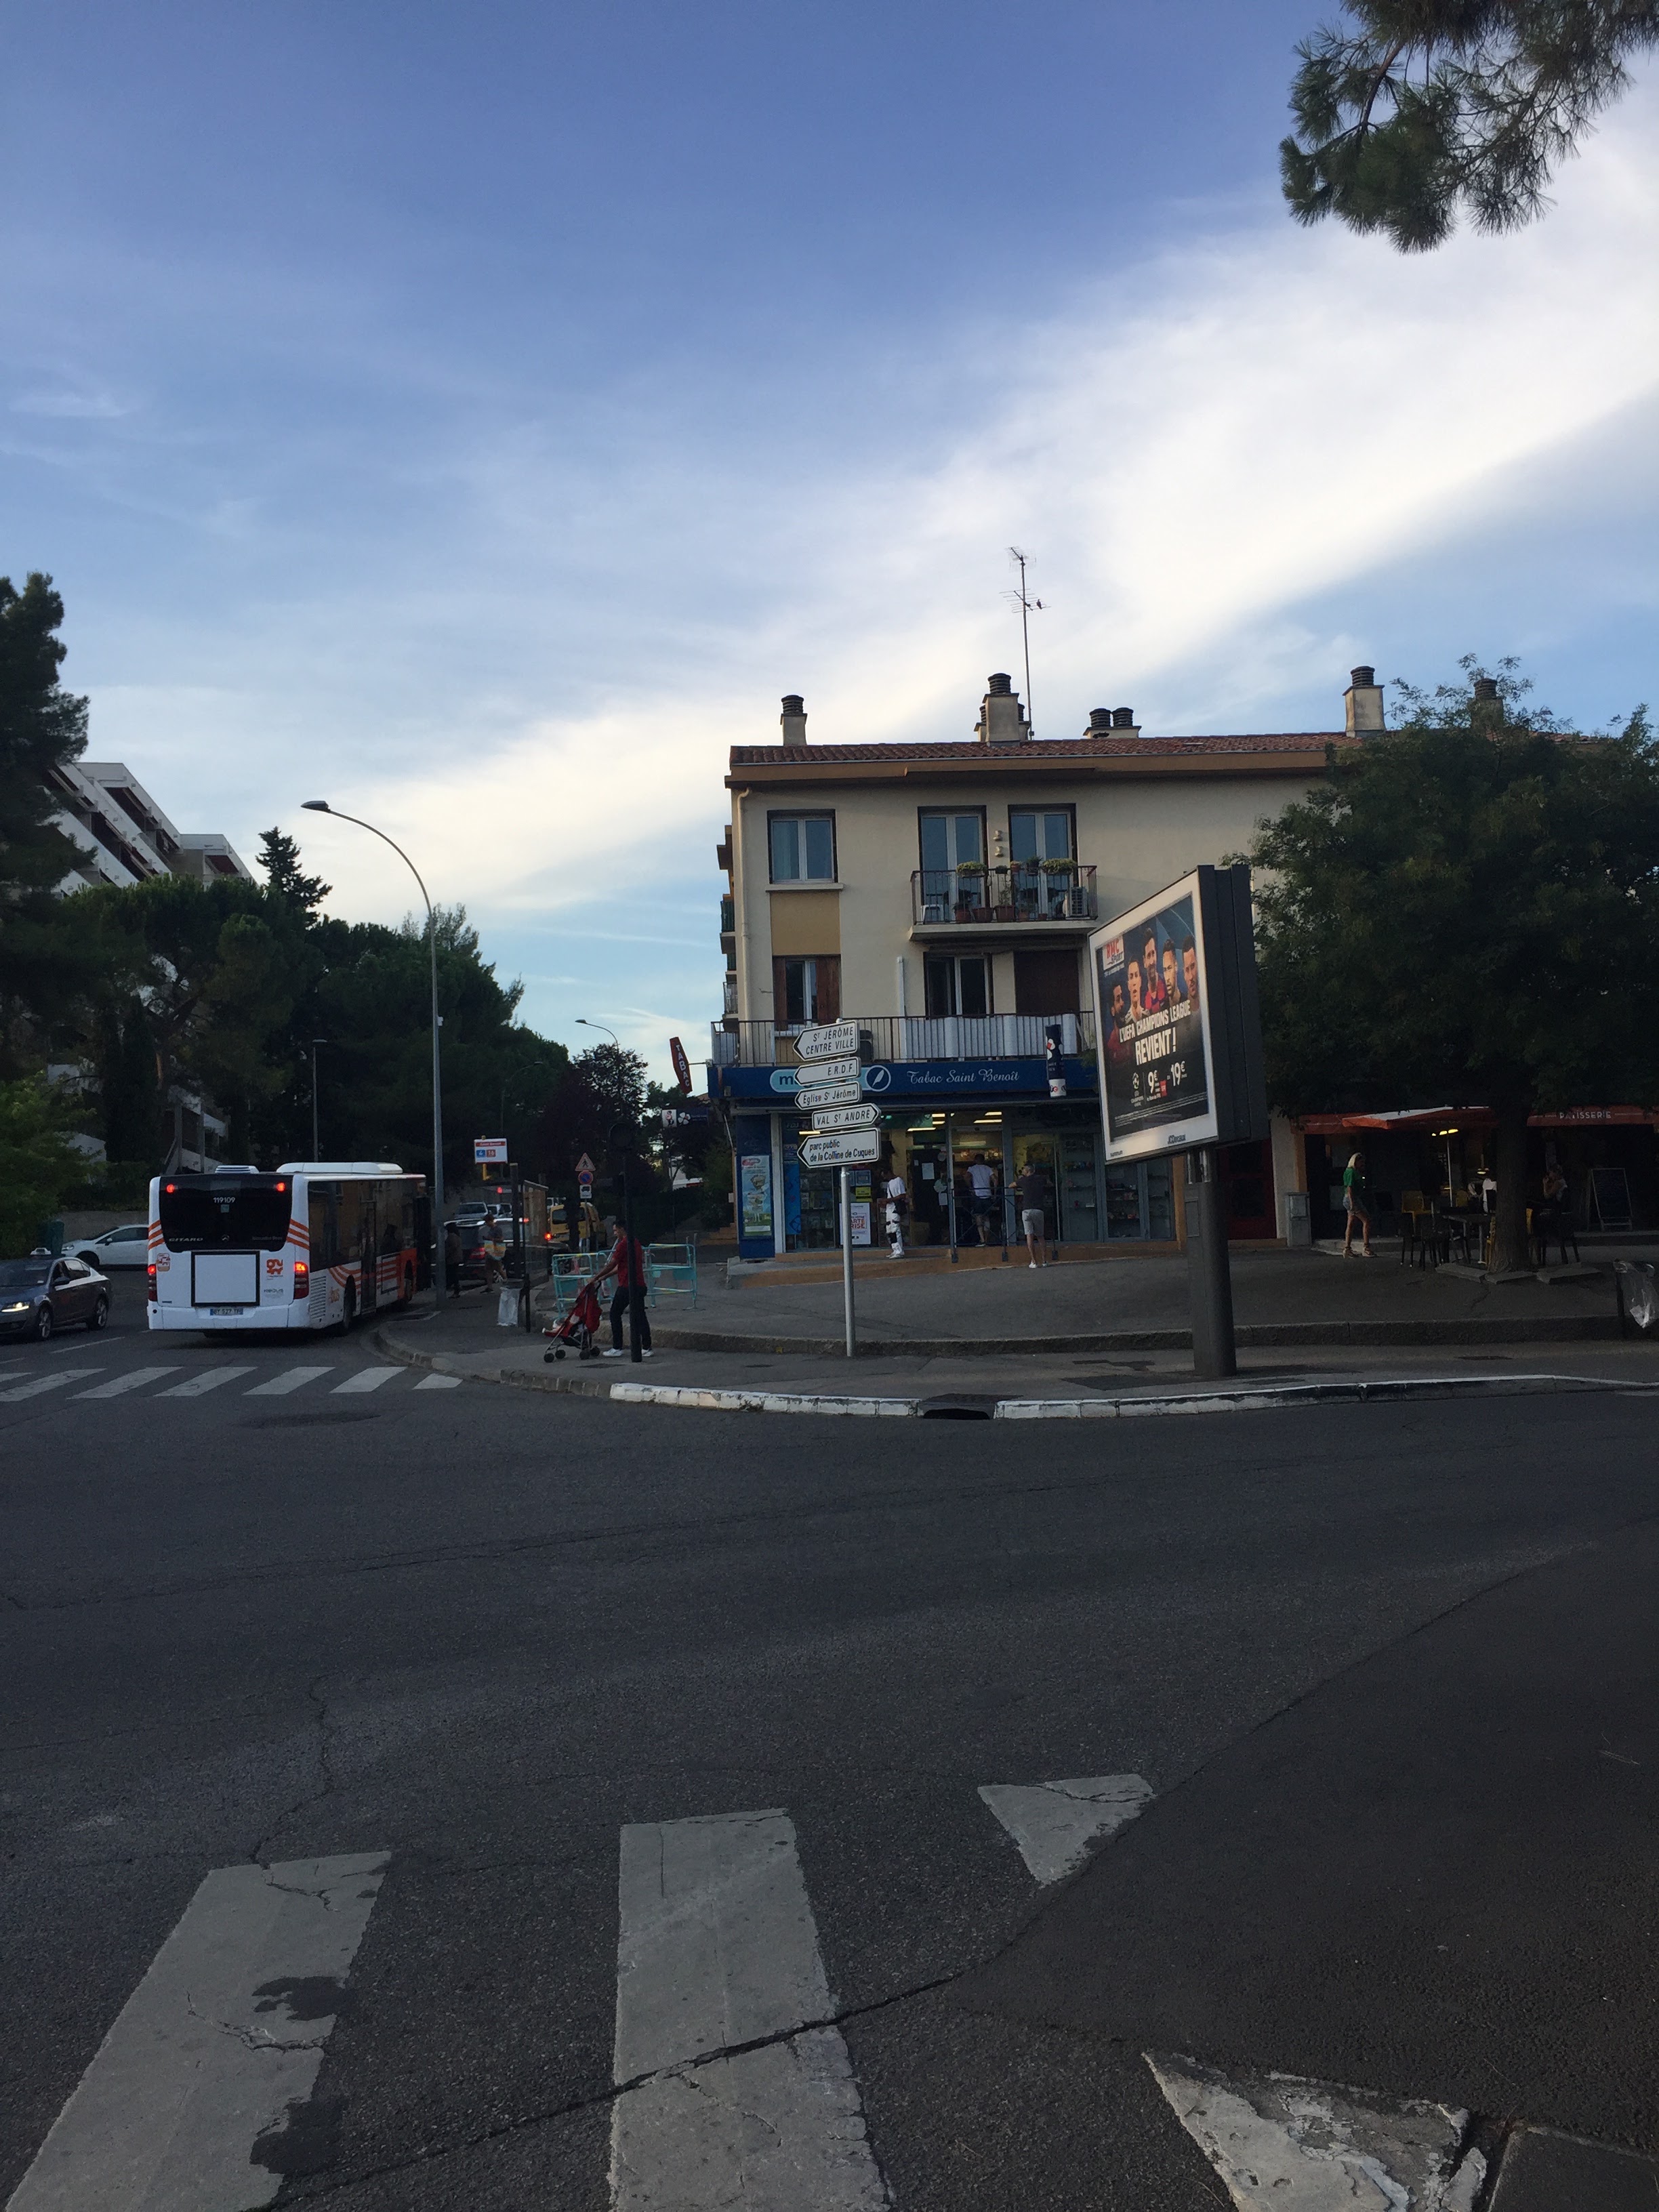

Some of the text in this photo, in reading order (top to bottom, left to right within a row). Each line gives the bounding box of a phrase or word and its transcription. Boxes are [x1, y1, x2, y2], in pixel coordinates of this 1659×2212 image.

[1119, 1000, 1191, 1043] L'UEFA CHAMPIONS LEAGUE
[823, 1026, 854, 1040] JÉRÔME
[806, 1038, 855, 1055] CENTRE VILLE
[675, 1044, 691, 1087] TABAC
[907, 1068, 1020, 1084] Tabac Saint Benoît
[802, 1093, 822, 1106] Église
[832, 1088, 856, 1100] Jérôme
[817, 1115, 830, 1126] VAL
[844, 1109, 871, 1122] ANDRÉ
[809, 1139, 840, 1153] parc public
[810, 1148, 876, 1162] de la Colline de Cuques
